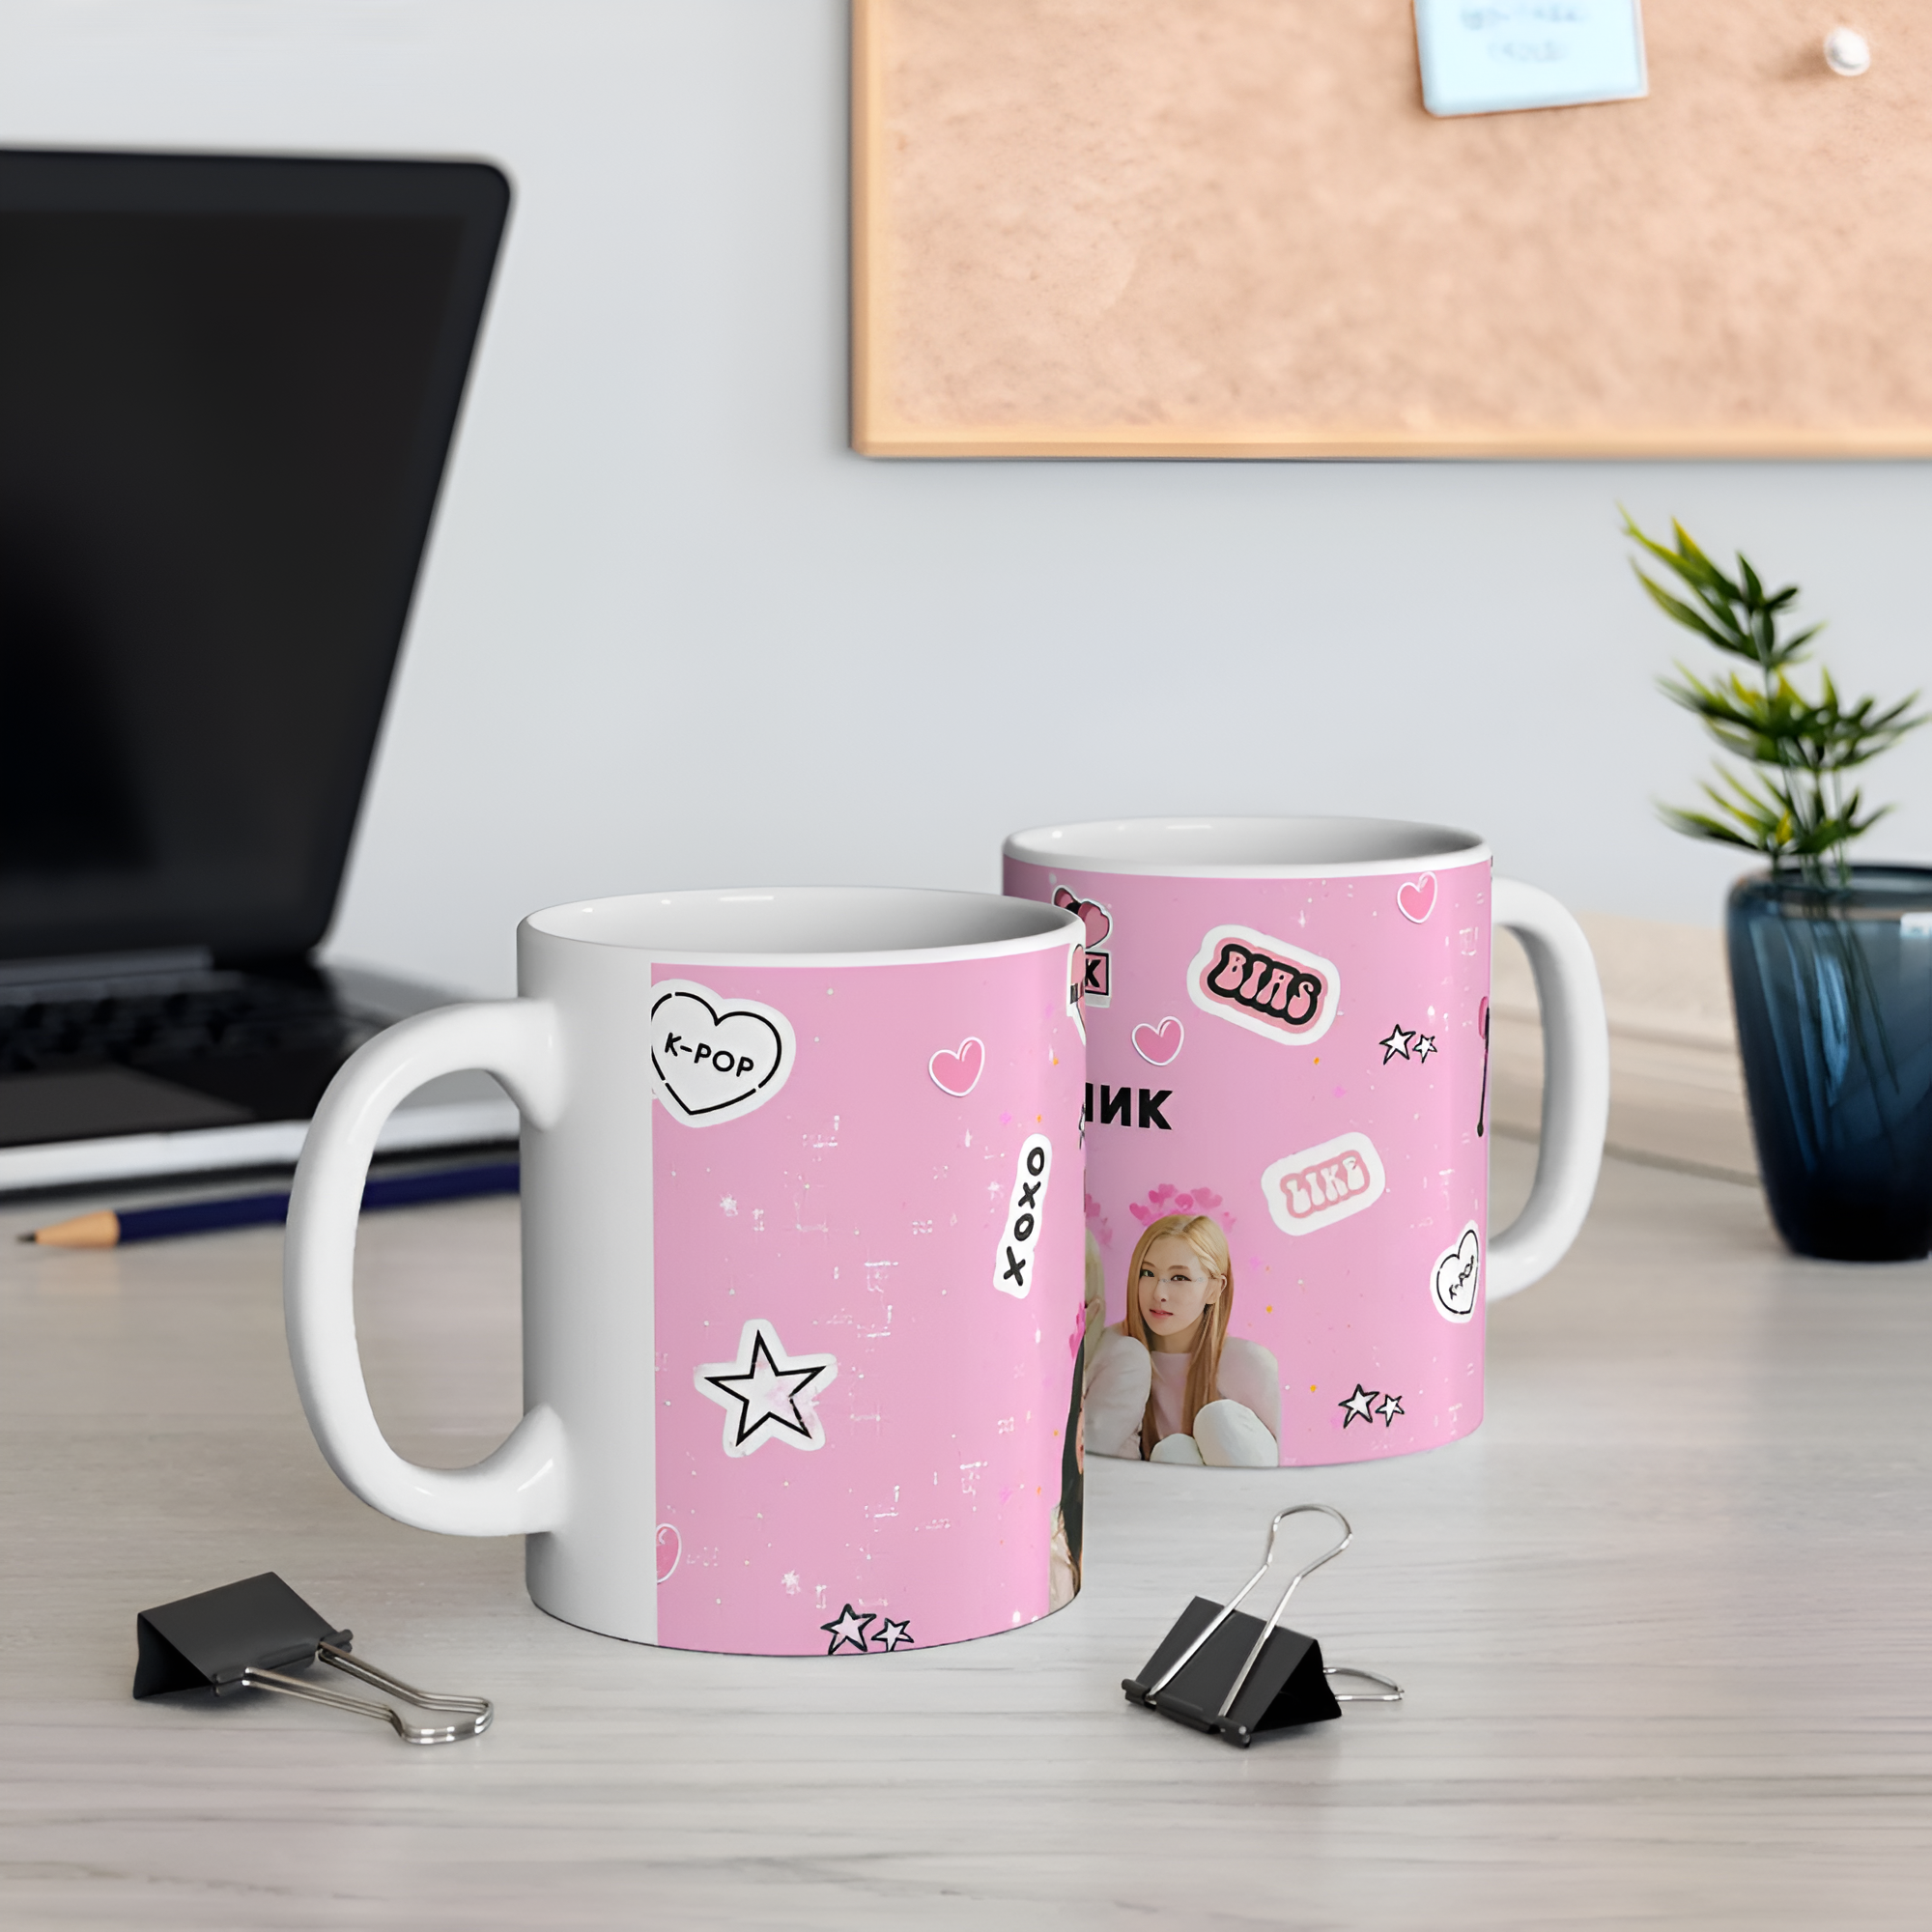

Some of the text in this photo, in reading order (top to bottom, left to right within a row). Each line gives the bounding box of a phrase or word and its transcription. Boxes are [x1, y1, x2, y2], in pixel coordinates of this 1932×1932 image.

[1211, 947, 1319, 1023] BIAS
[664, 1031, 755, 1078] K-POP
[1283, 1152, 1368, 1216] LIKE
